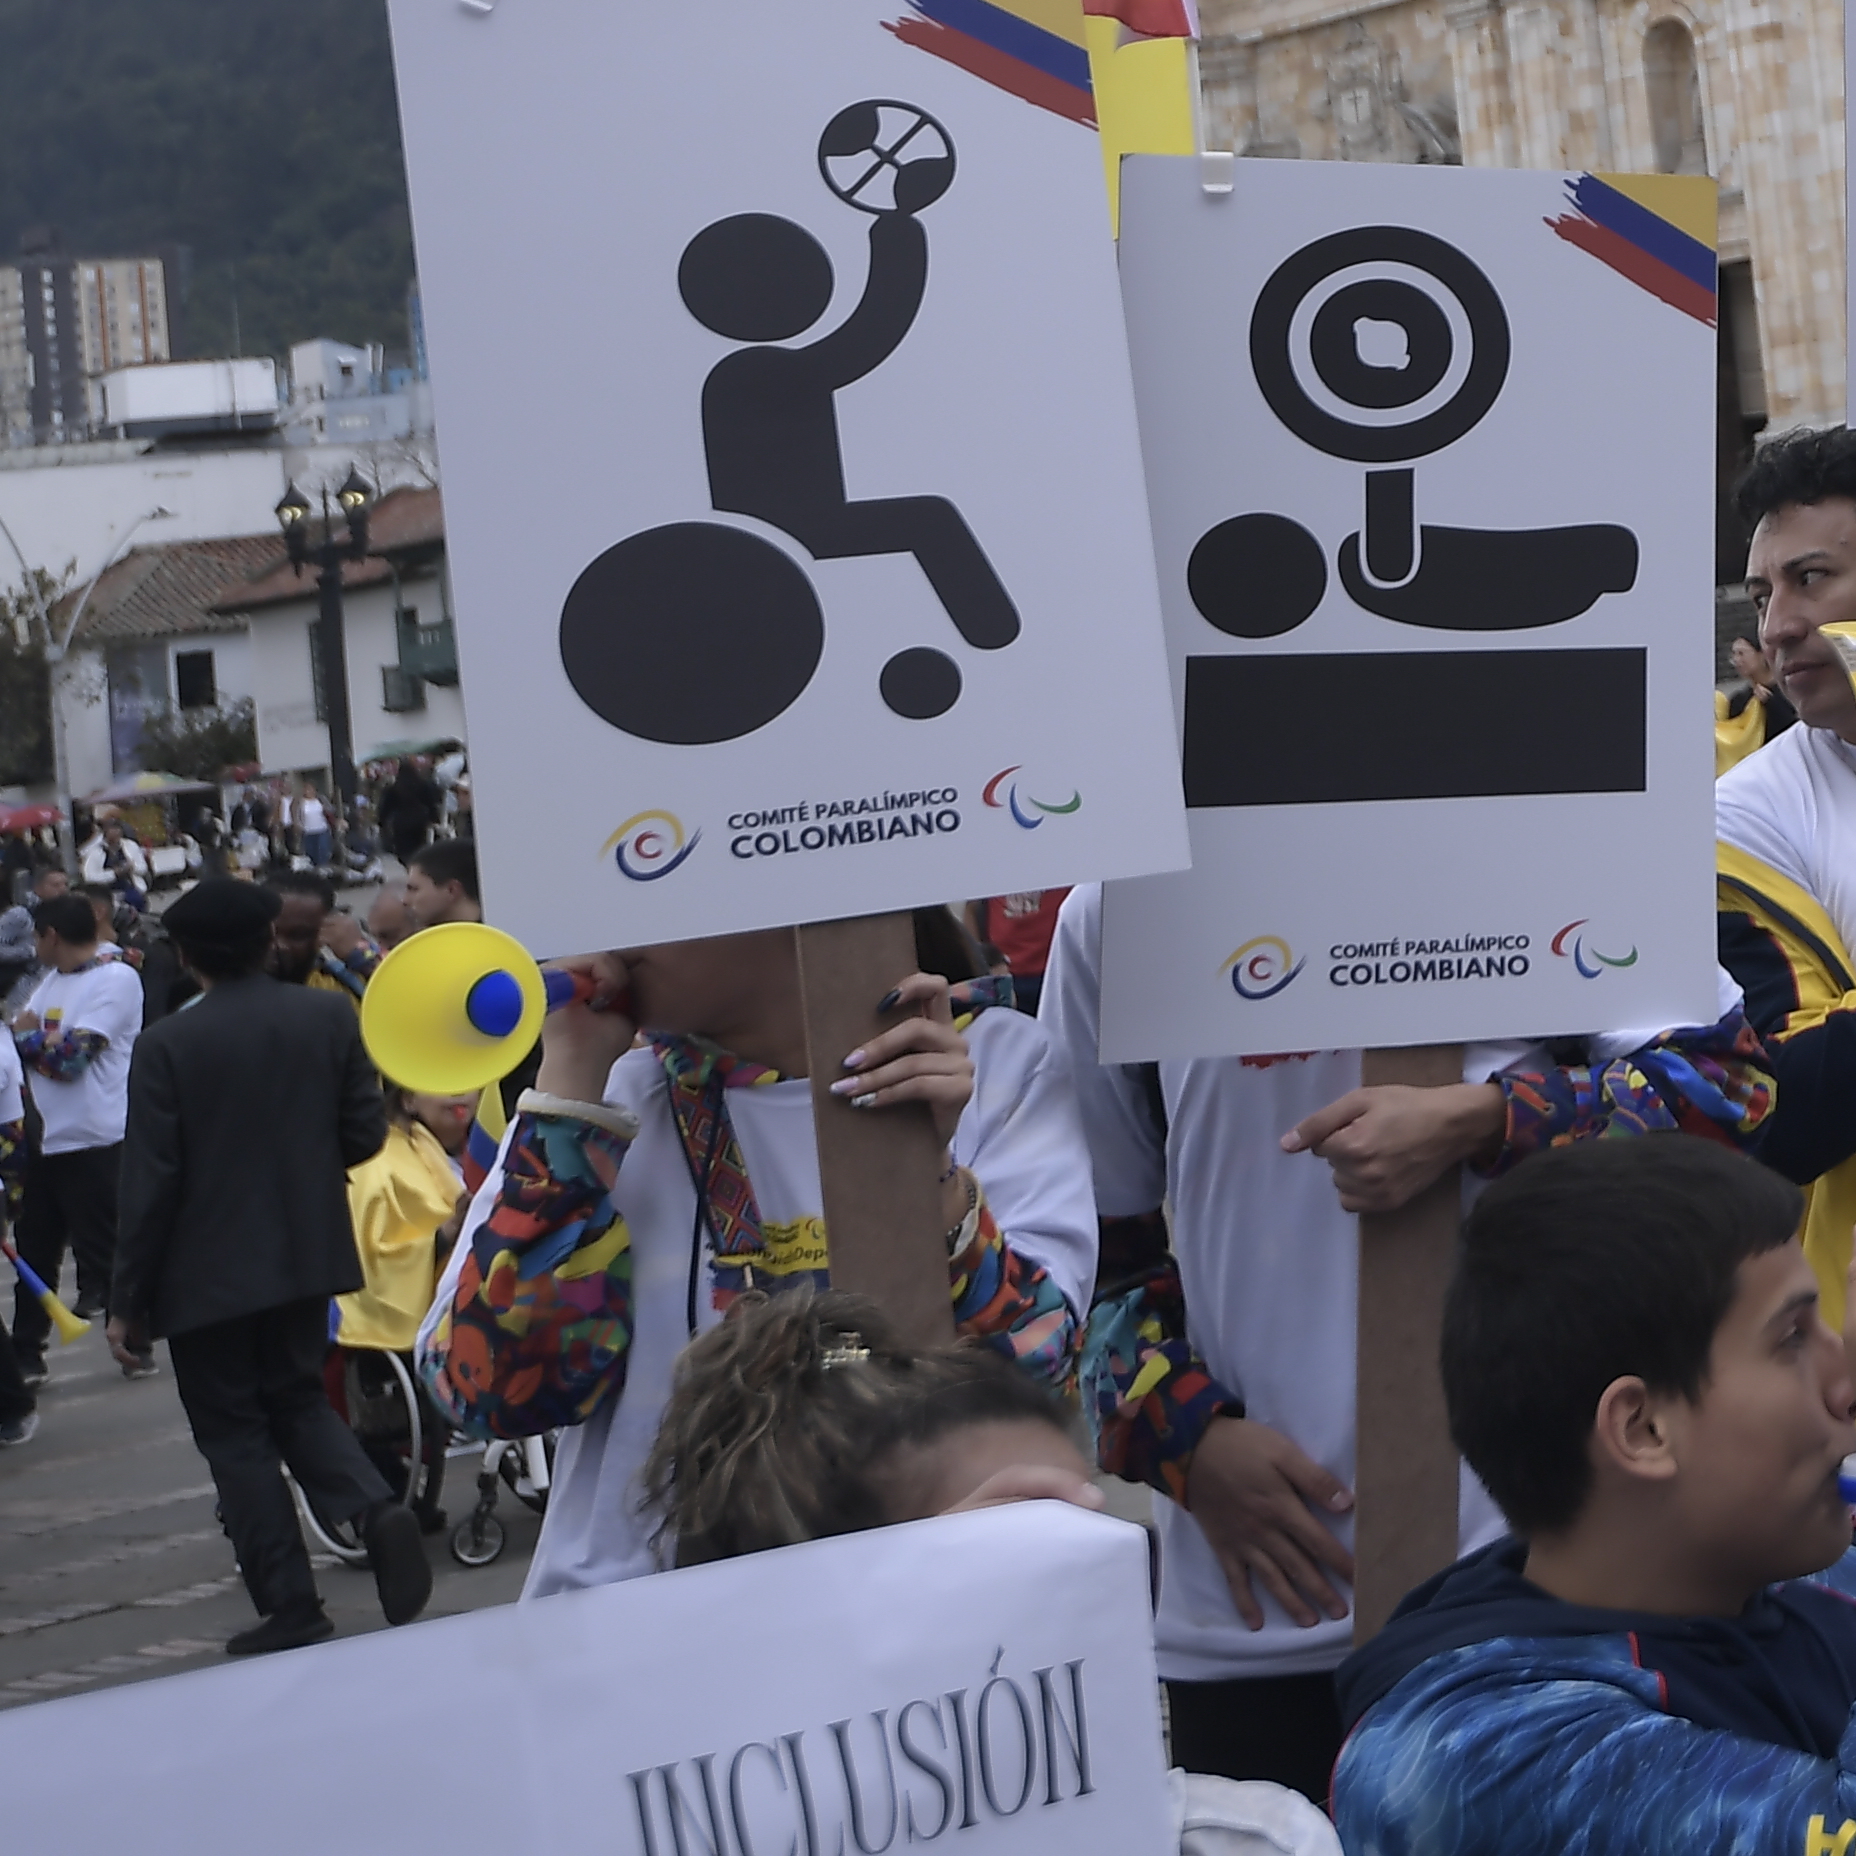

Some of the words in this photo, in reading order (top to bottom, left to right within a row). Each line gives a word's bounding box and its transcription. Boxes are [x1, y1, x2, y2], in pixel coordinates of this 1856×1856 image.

[728, 803, 809, 831] COMITÉ
[814, 787, 958, 820] PARALÍMPICO
[730, 807, 962, 859] COLOMBIANO
[1330, 937, 1400, 959] COMITÉ
[1404, 932, 1530, 957] PARALÍMPICO
[1329, 953, 1531, 986] COLOMBIANO
[626, 1644, 1097, 1856] INCLUSIÓN
